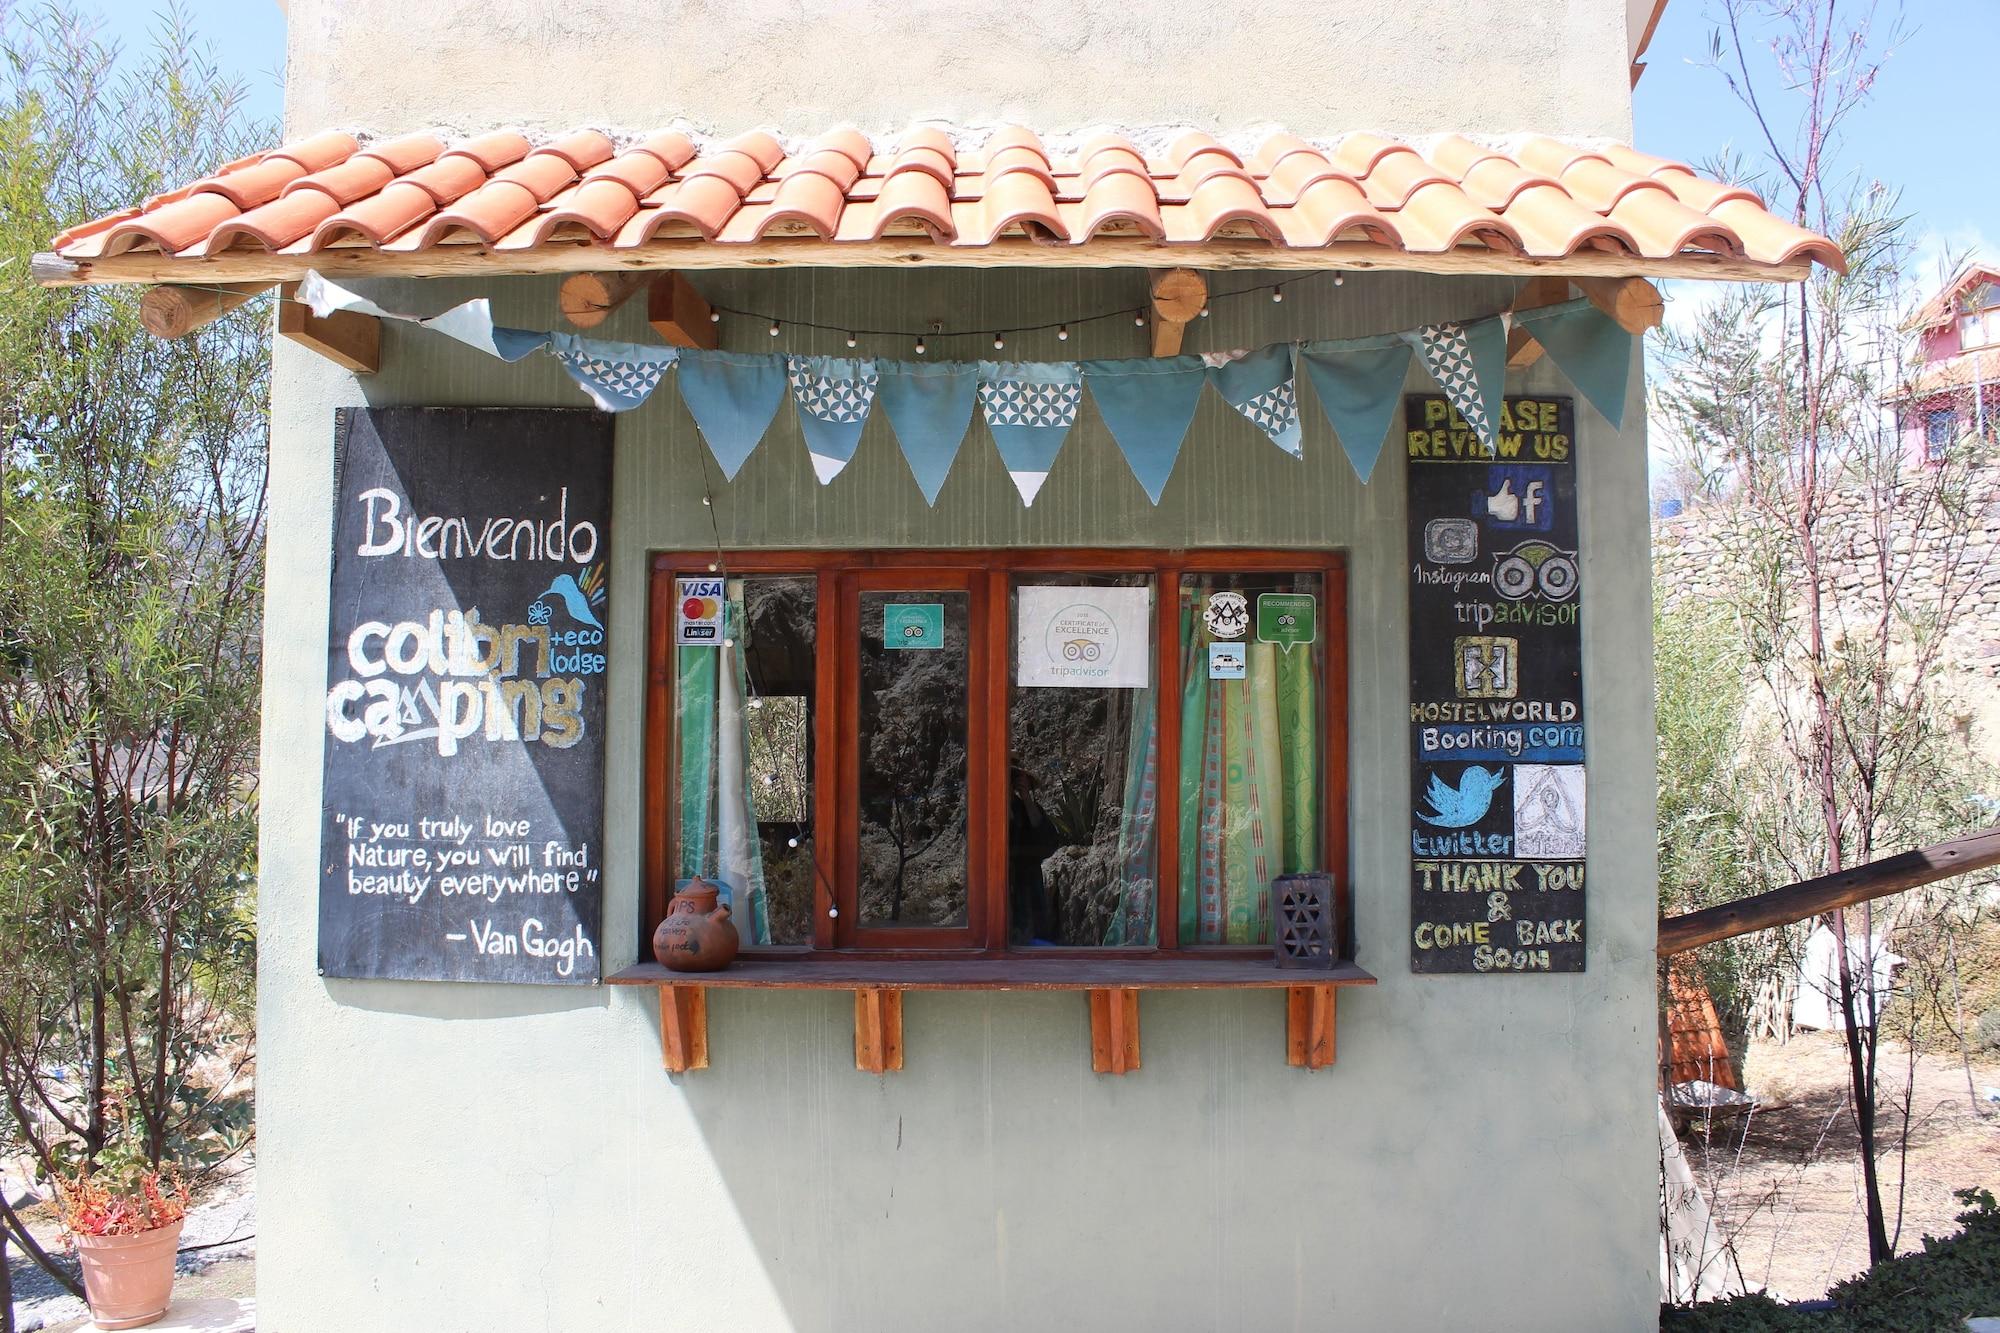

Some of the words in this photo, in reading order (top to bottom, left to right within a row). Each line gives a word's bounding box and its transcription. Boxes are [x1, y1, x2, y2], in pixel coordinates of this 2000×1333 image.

[1425, 400, 1558, 432] PLASE
[1534, 434, 1569, 460] US
[357, 486, 598, 563] Bienvenido
[681, 583, 721, 596] VISA
[1413, 564, 1491, 593] Instagram
[1060, 619, 1098, 627] CERTIFICATE
[1454, 599, 1580, 632] tripadvisor
[1055, 626, 1109, 635] EXCELLENCE
[550, 647, 606, 675] lodge
[1051, 666, 1109, 677] tripadvisor
[1410, 701, 1577, 723] HOSTELWORLD
[1422, 725, 1583, 757] Booking.com
[371, 822, 410, 843] you
[420, 815, 473, 845] truly
[486, 815, 530, 836] love
[1412, 829, 1513, 856] twitter
[349, 843, 432, 872] Nature,
[435, 851, 480, 872] you
[542, 841, 588, 867] find
[349, 869, 431, 904] beauty
[1415, 863, 1523, 892] THANK
[1532, 864, 1584, 892] YOU
[1487, 891, 1511, 922] &
[522, 918, 593, 976] Gogh
[1414, 921, 1489, 949] COME
[1516, 919, 1583, 945] BACK
